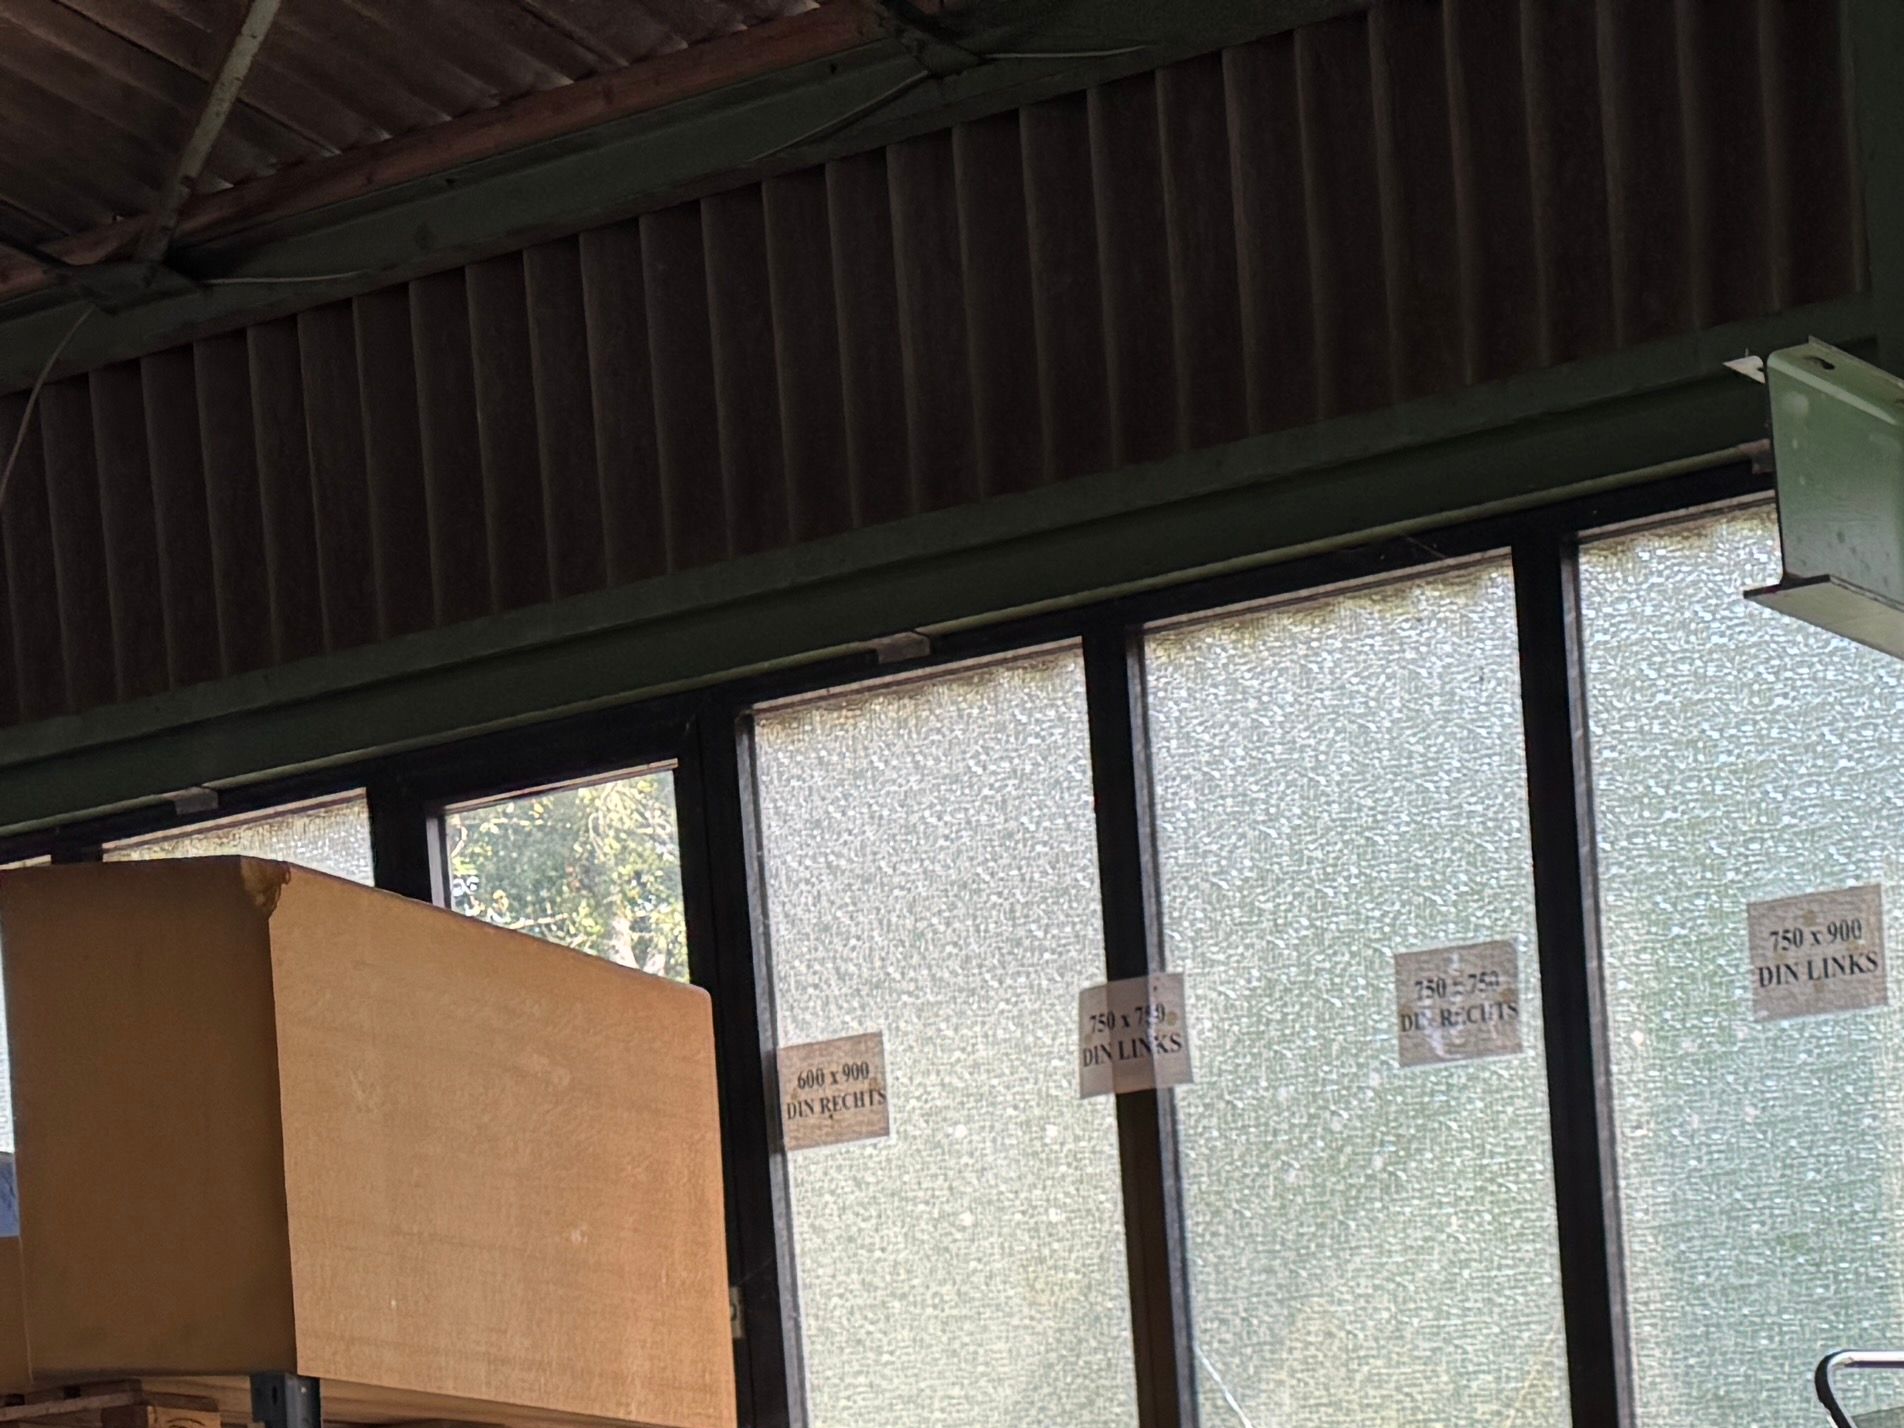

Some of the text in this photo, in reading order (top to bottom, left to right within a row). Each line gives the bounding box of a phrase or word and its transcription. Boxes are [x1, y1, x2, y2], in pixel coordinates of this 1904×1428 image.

[1769, 919, 1862, 951] 750 x 900
[1758, 951, 1878, 988] DIN LINKS
[1089, 1010, 1115, 1034] 750
[1400, 1010, 1432, 1032] DI
[1083, 1042, 1112, 1067] DIN
[797, 1061, 870, 1089] 600 x 900
[787, 1088, 886, 1120] DIN RECHTS
